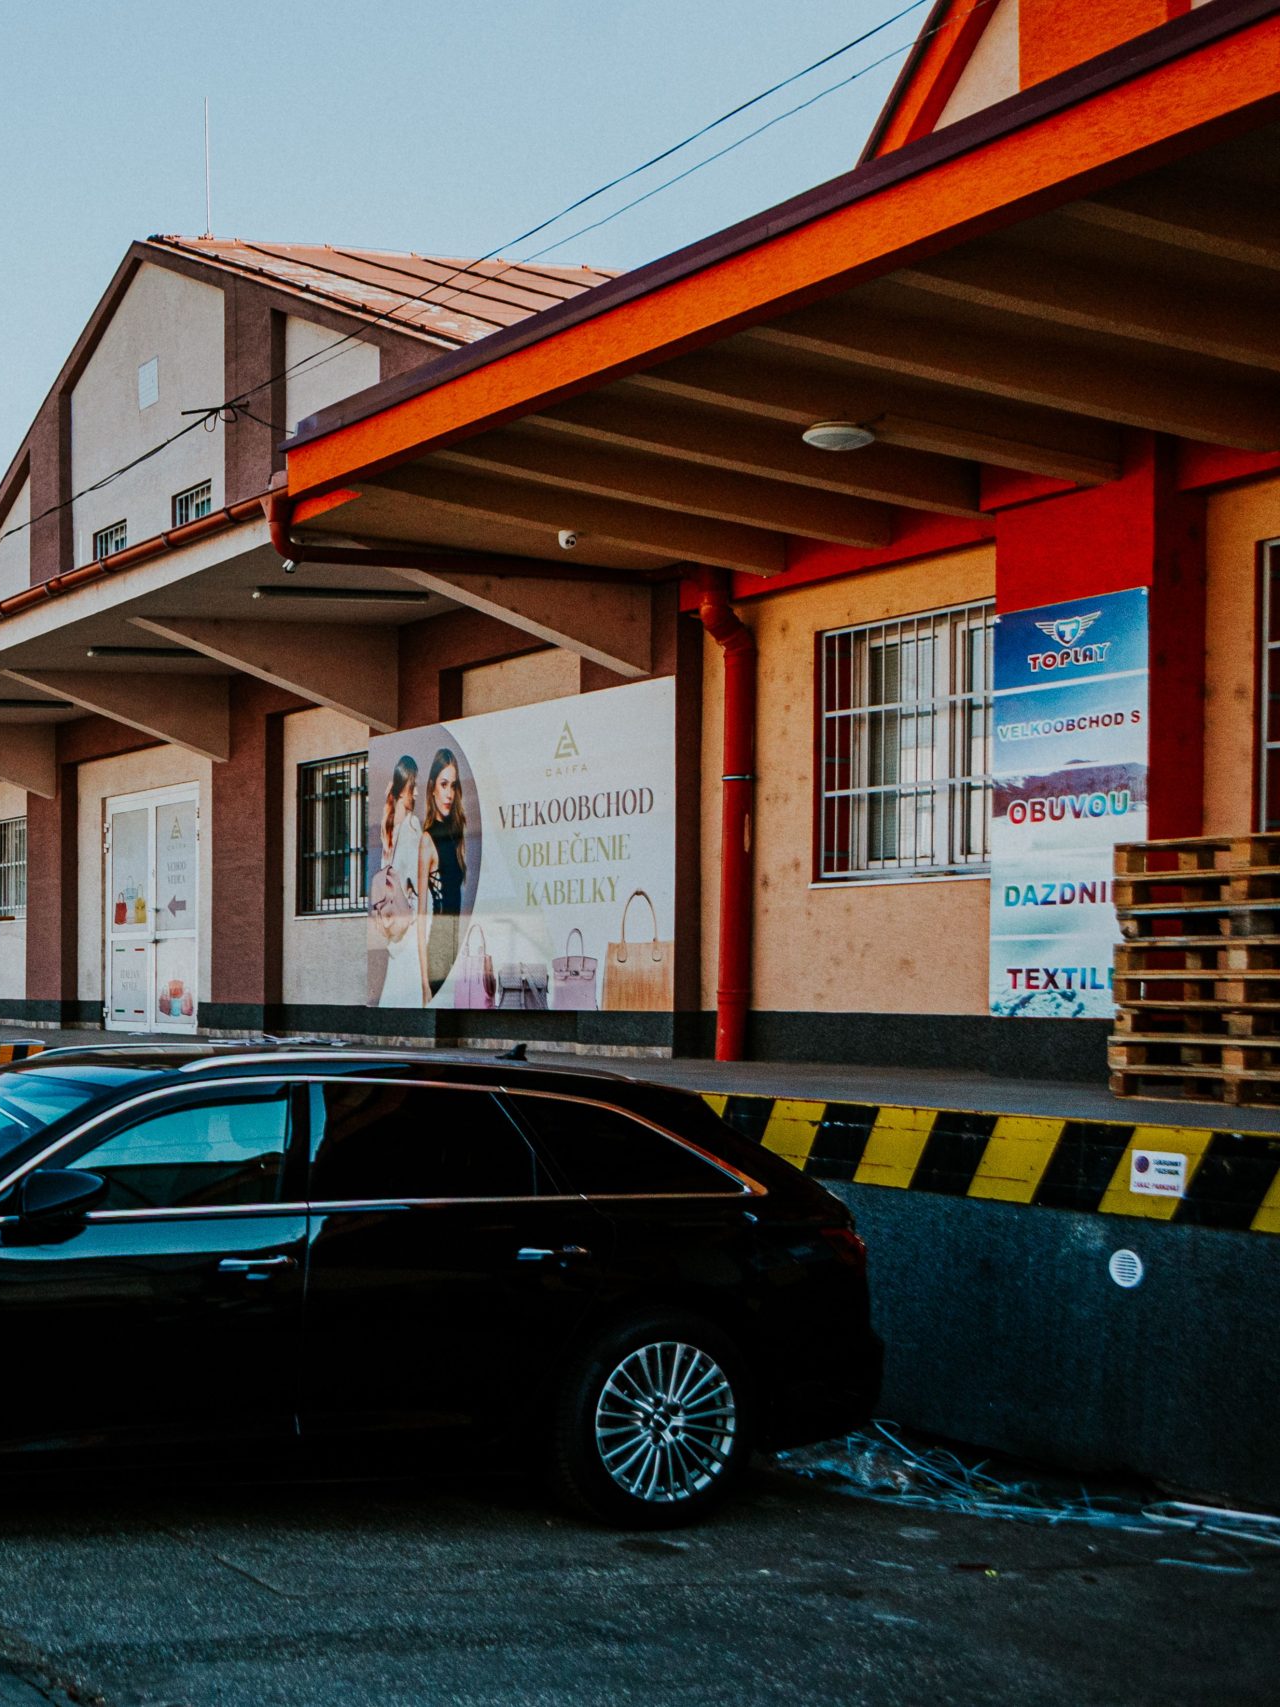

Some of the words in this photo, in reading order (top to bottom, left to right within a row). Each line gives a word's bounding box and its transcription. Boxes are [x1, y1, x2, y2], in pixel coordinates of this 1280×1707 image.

[1028, 642, 1111, 672] TOPLAY
[998, 711, 1125, 741] VELKOOBCHOD
[1130, 710, 1141, 724] S
[1008, 791, 1130, 825] OBUVOU
[517, 833, 631, 868] OBLEČENIE
[525, 875, 620, 907] KABELKY
[1004, 881, 1115, 907] DAZDNI
